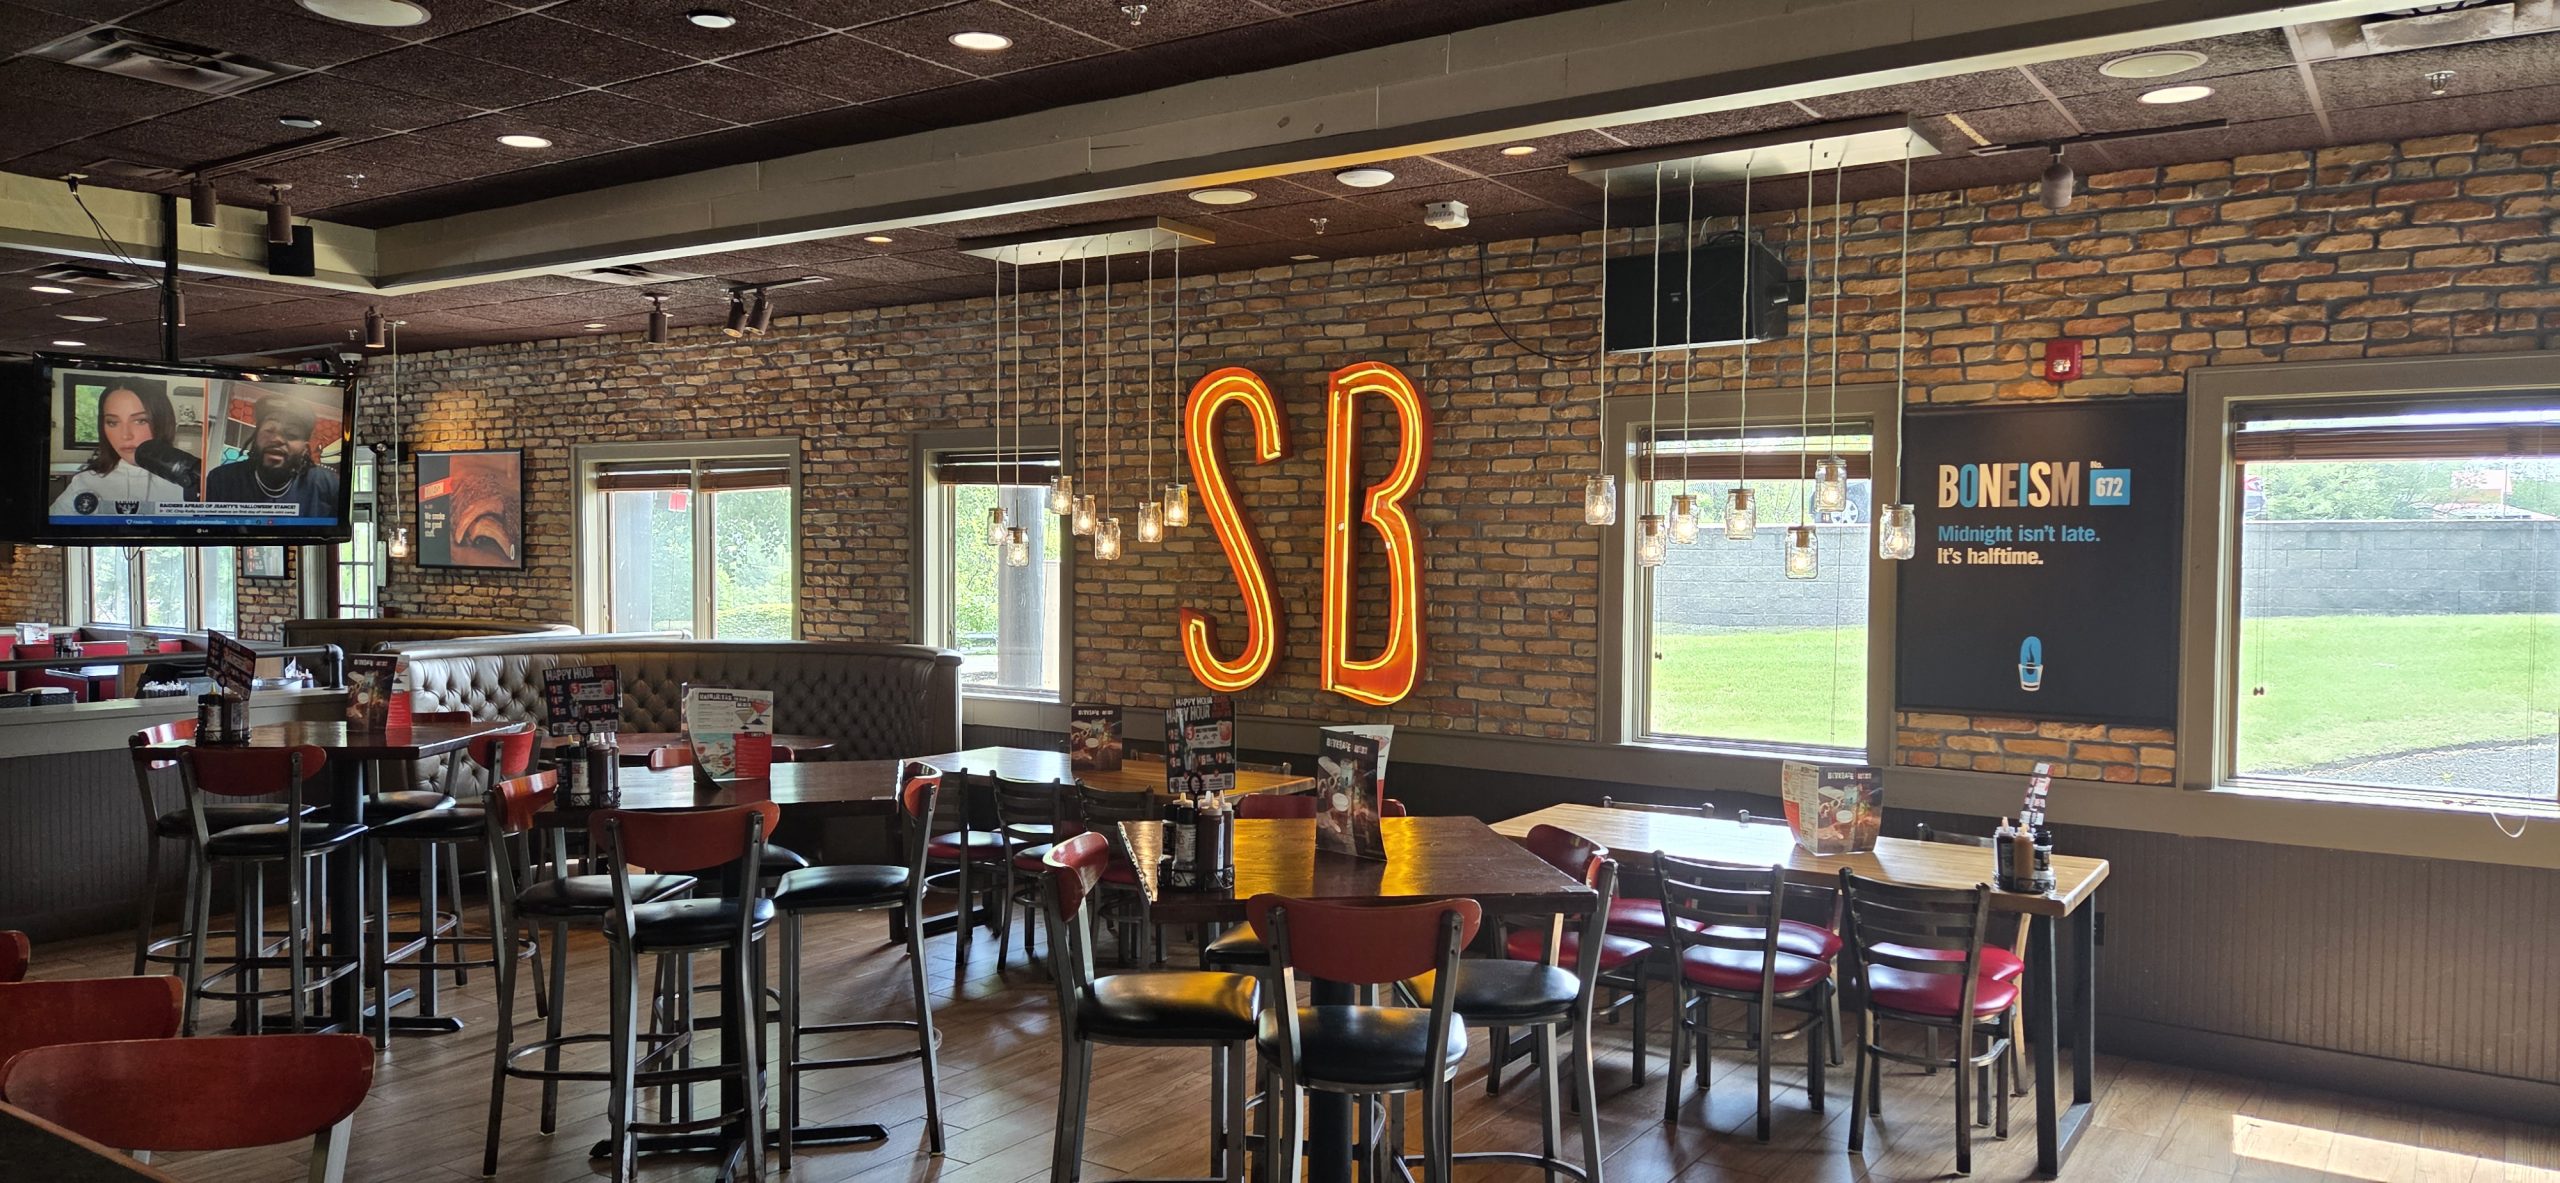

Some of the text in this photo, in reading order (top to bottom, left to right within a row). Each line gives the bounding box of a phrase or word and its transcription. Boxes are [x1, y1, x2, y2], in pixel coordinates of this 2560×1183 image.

[1937, 461, 2080, 508] BONEISM
[2095, 476, 2123, 497] 672
[1937, 525, 2100, 545] Midnight isn't late.
[1937, 547, 2043, 565] It's halftime.
[545, 668, 572, 681] HAPPY
[573, 666, 595, 680] HOUR
[1176, 696, 1213, 706] HAPPY HOUR
[1166, 707, 1189, 724] HAPPY
[1190, 704, 1210, 721] HOUR
